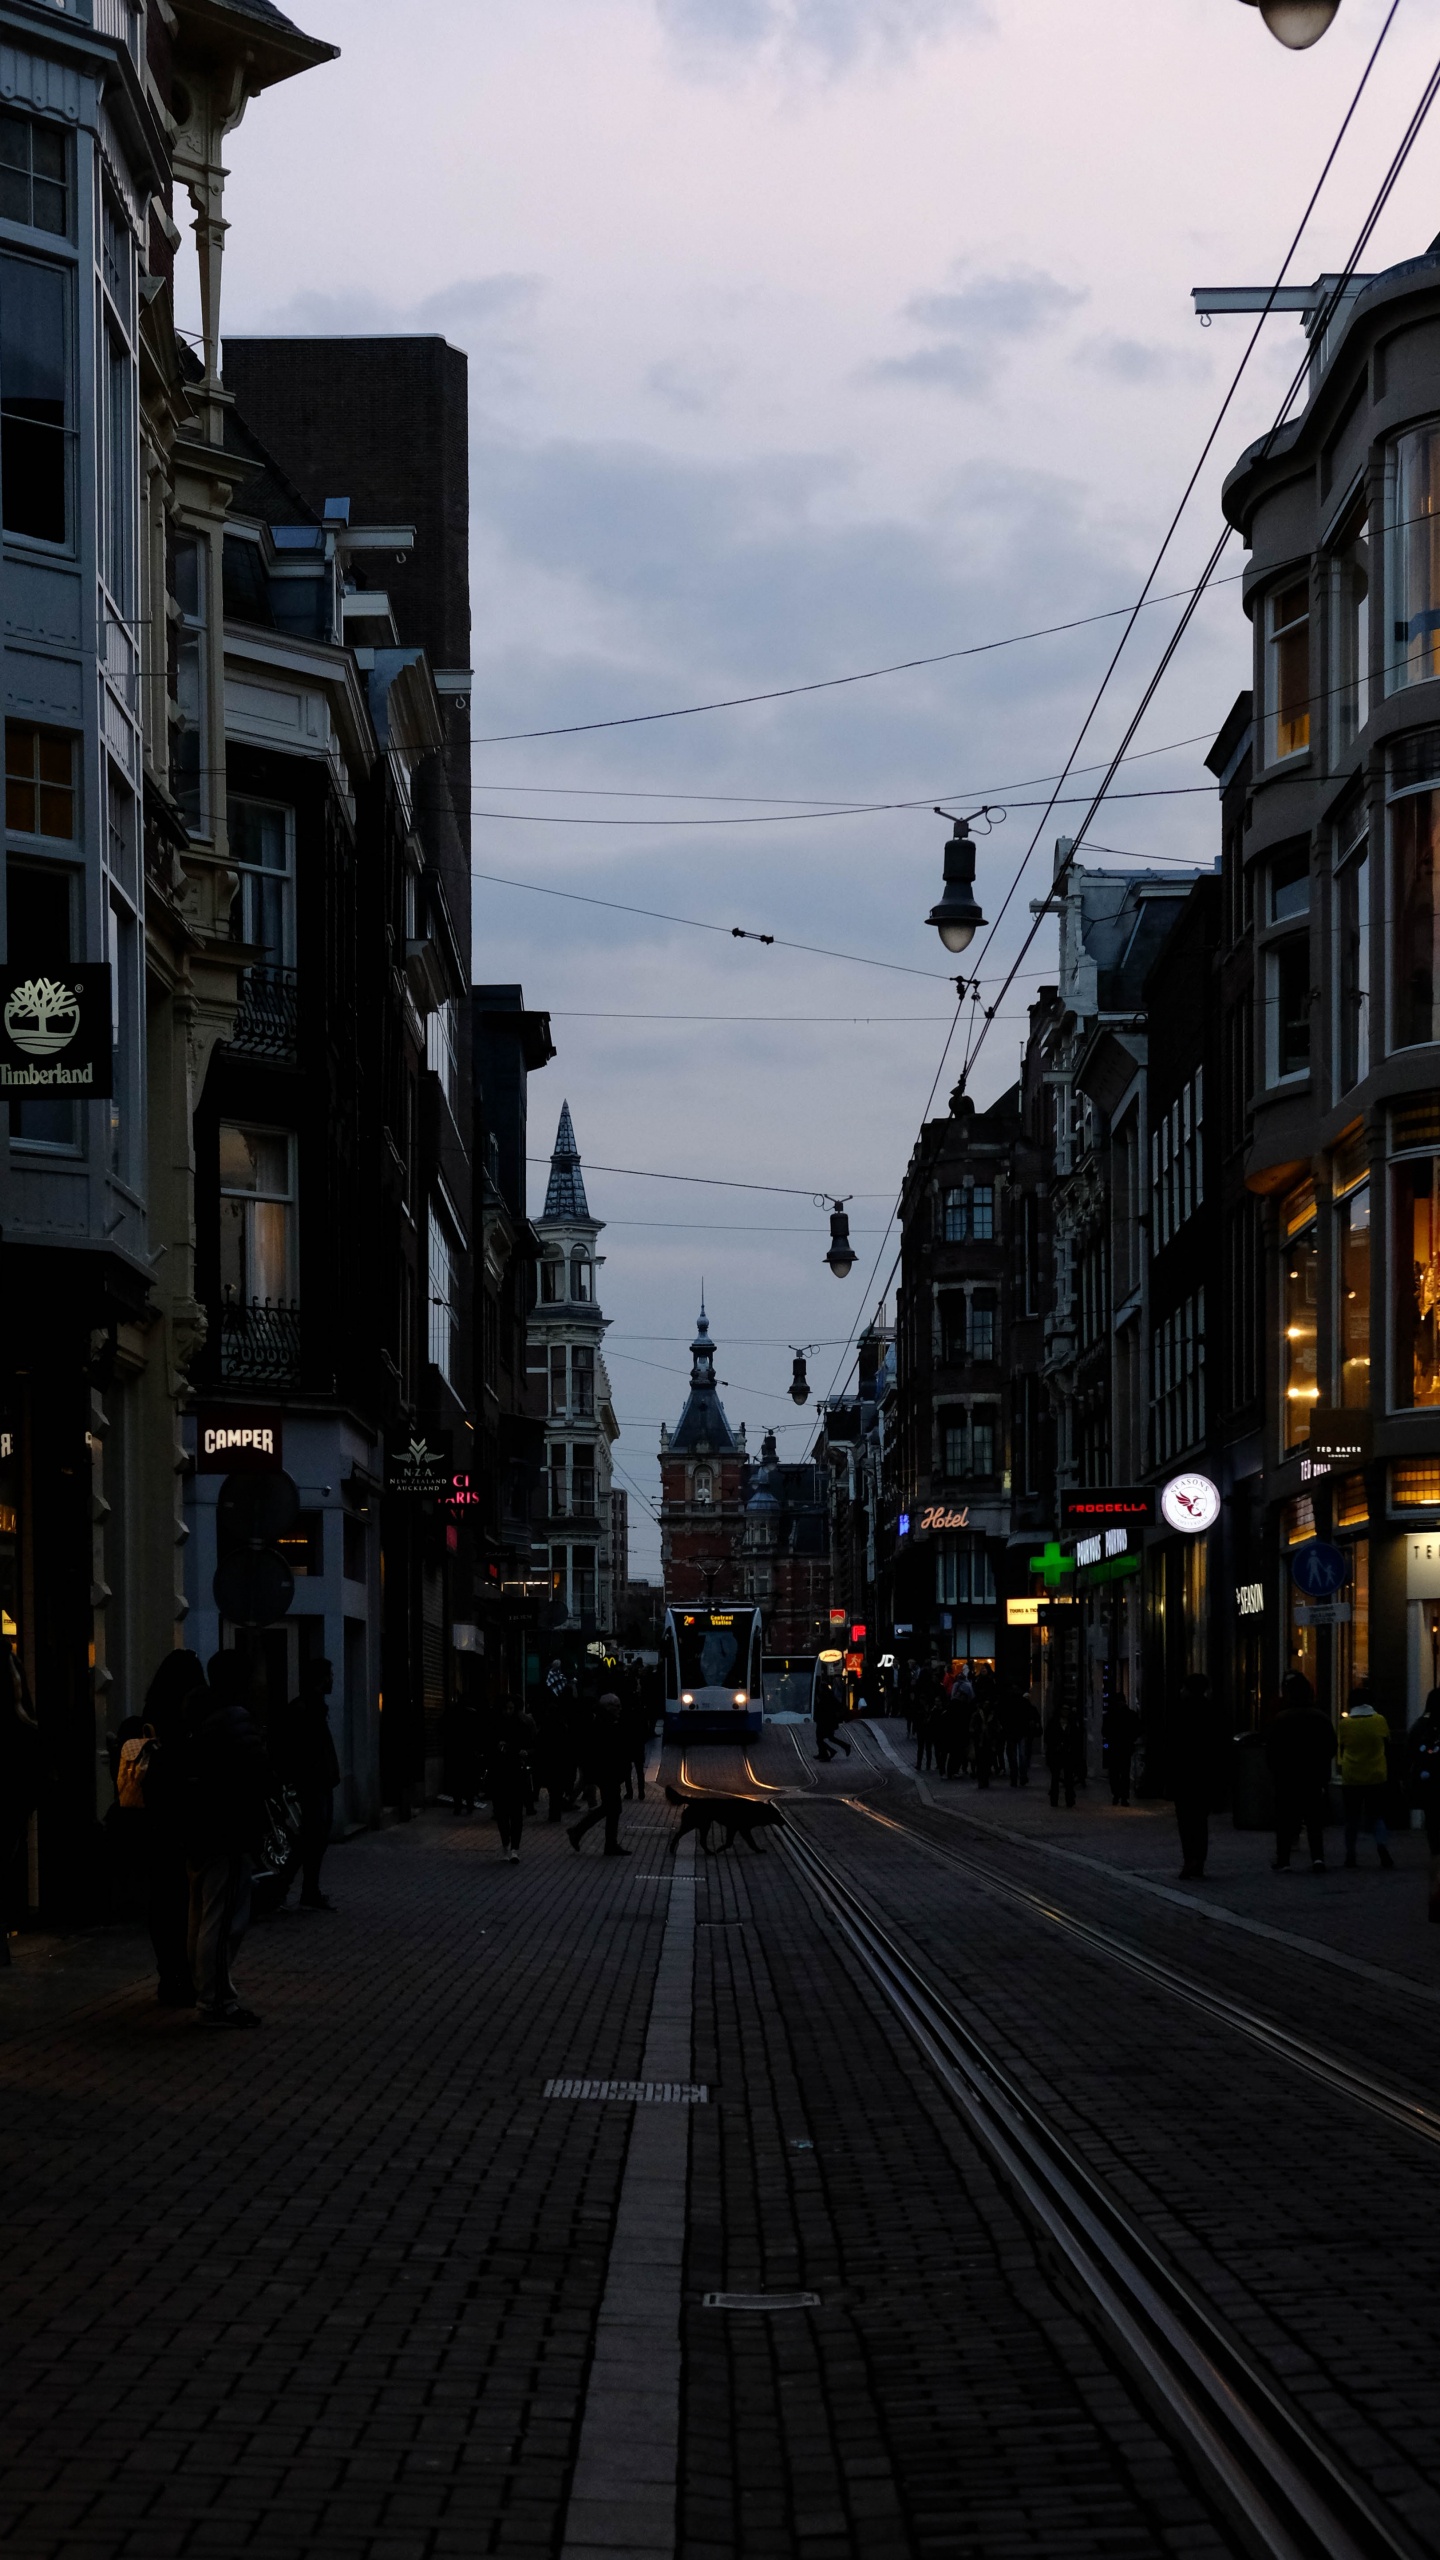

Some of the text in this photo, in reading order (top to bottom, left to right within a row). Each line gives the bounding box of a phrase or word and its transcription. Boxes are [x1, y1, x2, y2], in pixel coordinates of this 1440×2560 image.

[0, 1062, 93, 1085] Timberland
[204, 1429, 274, 1454] CAMPER
[1300, 1459, 1311, 1481] TED
[1170, 1478, 1210, 1493] SEASONS
[921, 1506, 969, 1529] Hotel
[1413, 1545, 1440, 1560] TE
[684, 1615, 689, 1626] 2
[877, 1654, 895, 1667] JD
